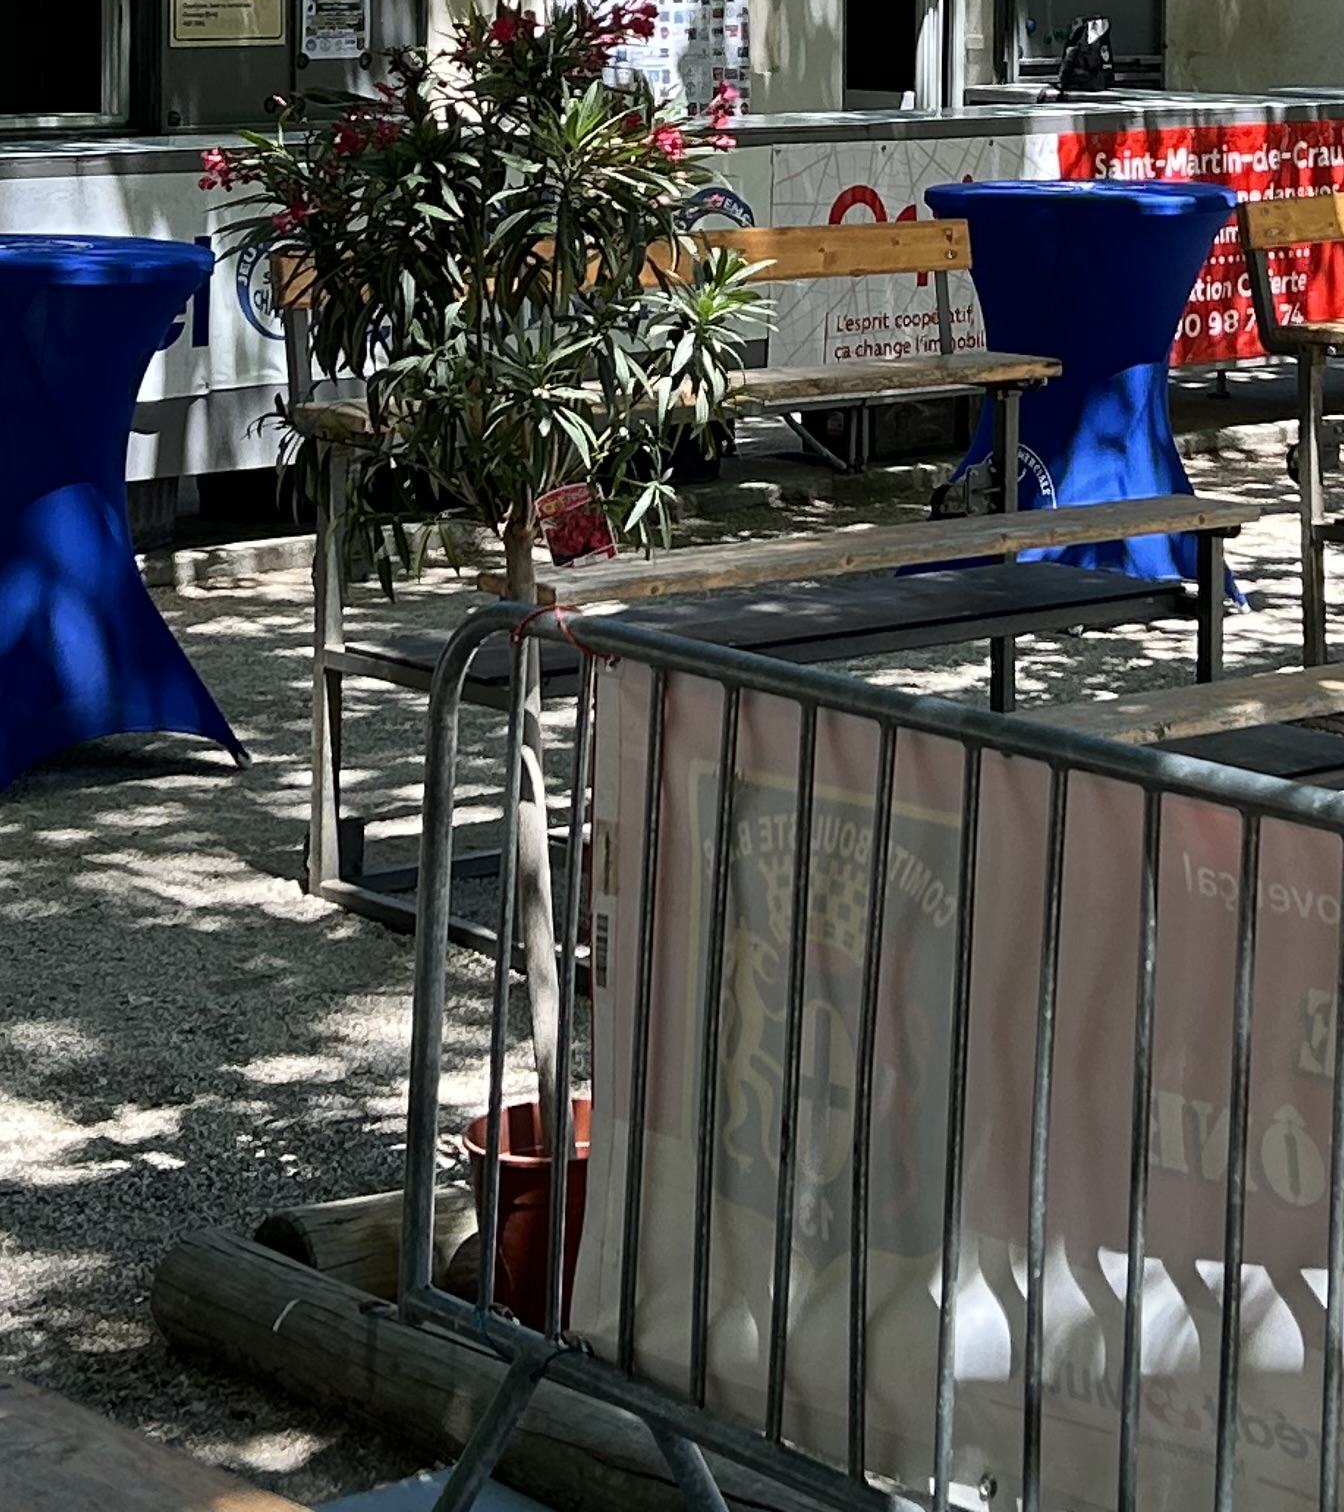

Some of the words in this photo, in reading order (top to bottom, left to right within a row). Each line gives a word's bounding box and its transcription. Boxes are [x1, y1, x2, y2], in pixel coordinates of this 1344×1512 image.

[1095, 139, 1344, 180] Saint-Martin-de-Crau
[836, 311, 890, 335] L'esprit
[894, 304, 975, 330] coopéatif,
[1207, 308, 1240, 336] 98
[1278, 301, 1305, 326] 74
[834, 344, 851, 364] ça
[855, 338, 912, 360] change
